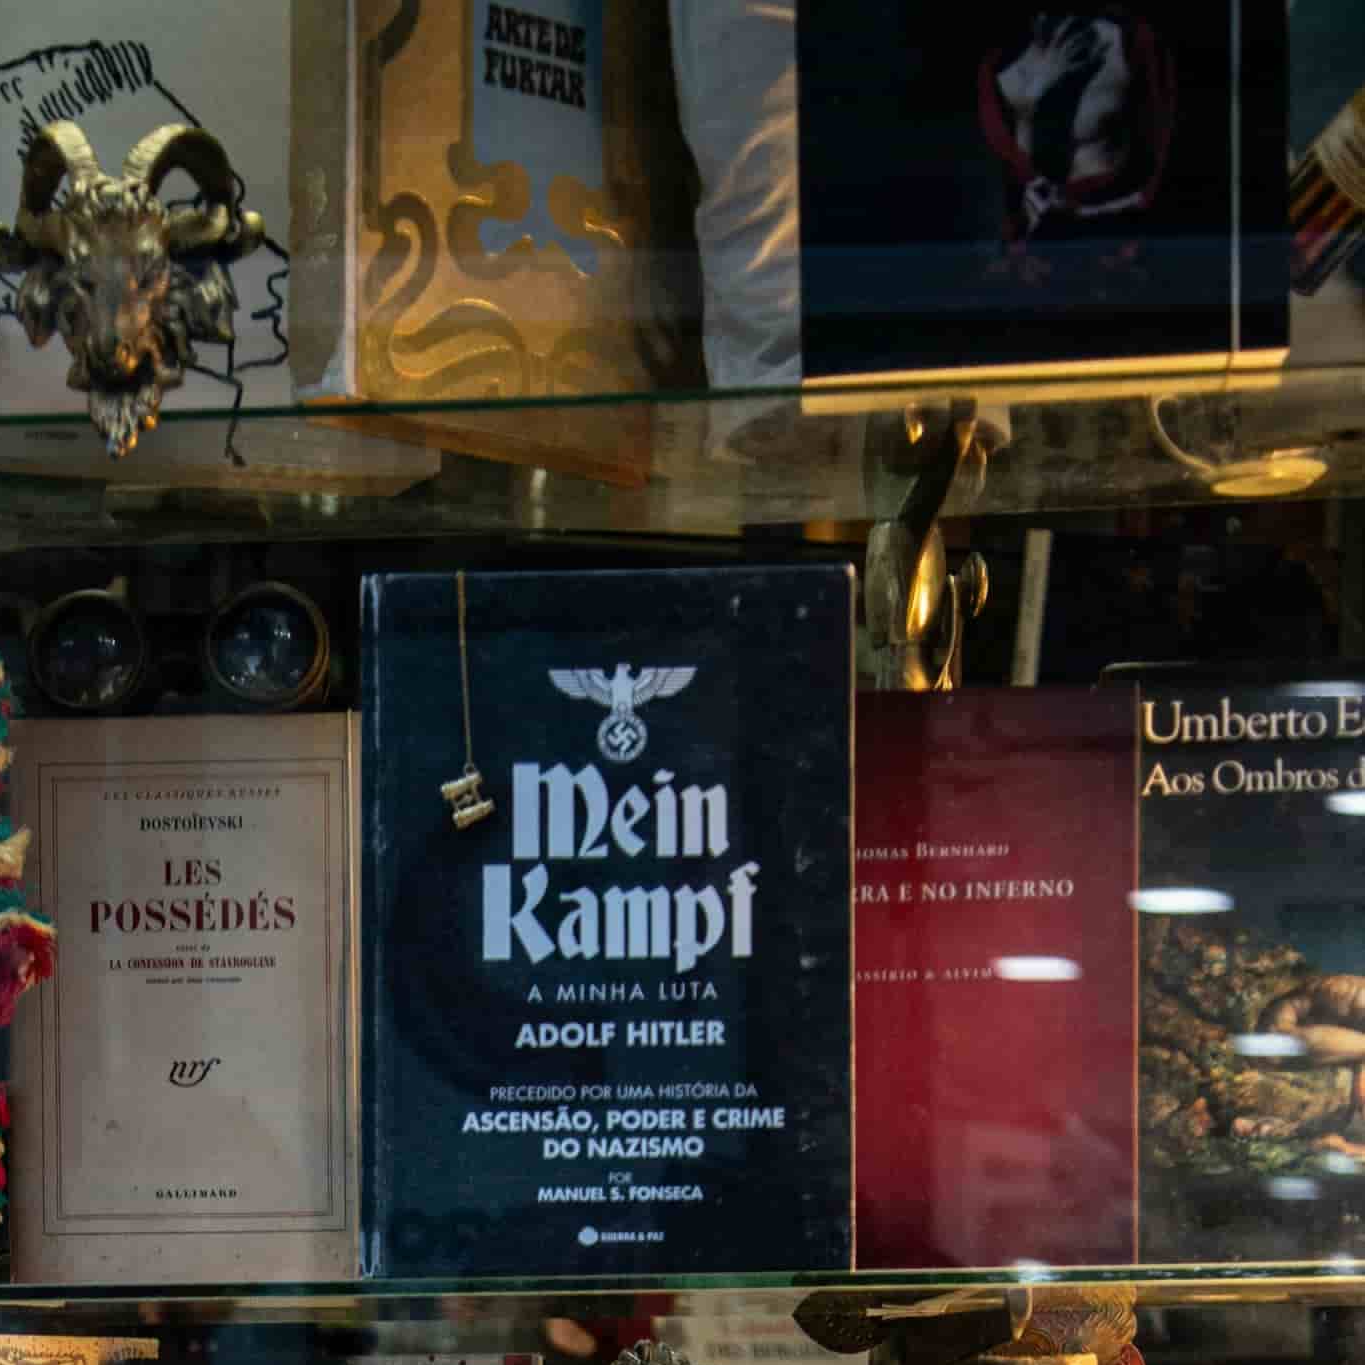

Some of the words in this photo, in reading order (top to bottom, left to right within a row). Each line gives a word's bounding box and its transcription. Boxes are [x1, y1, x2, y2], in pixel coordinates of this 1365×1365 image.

[510, 761, 730, 860] Mein
[163, 857, 223, 888] LES
[89, 888, 299, 935] POSSÉDÉS
[480, 860, 762, 975] Kampf
[526, 982, 543, 1004] A
[554, 981, 647, 1003] MINHA
[657, 980, 720, 1002] LUTA
[514, 1022, 618, 1050] ADOLF
[625, 1020, 728, 1049] HITLER
[168, 1056, 222, 1089] nrf
[489, 1084, 577, 1103] PRECEDIDO
[582, 1084, 613, 1101] POR
[616, 1083, 655, 1101] UMA
[657, 1080, 733, 1101] HISTÓRIA
[734, 1081, 760, 1100] DA
[460, 1105, 599, 1136] ASCENSÃO,
[605, 1107, 688, 1133] PODER
[692, 1108, 706, 1130] E
[711, 1105, 787, 1130] CRIME
[542, 1136, 582, 1160] DO
[586, 1135, 707, 1160] NAZISMO
